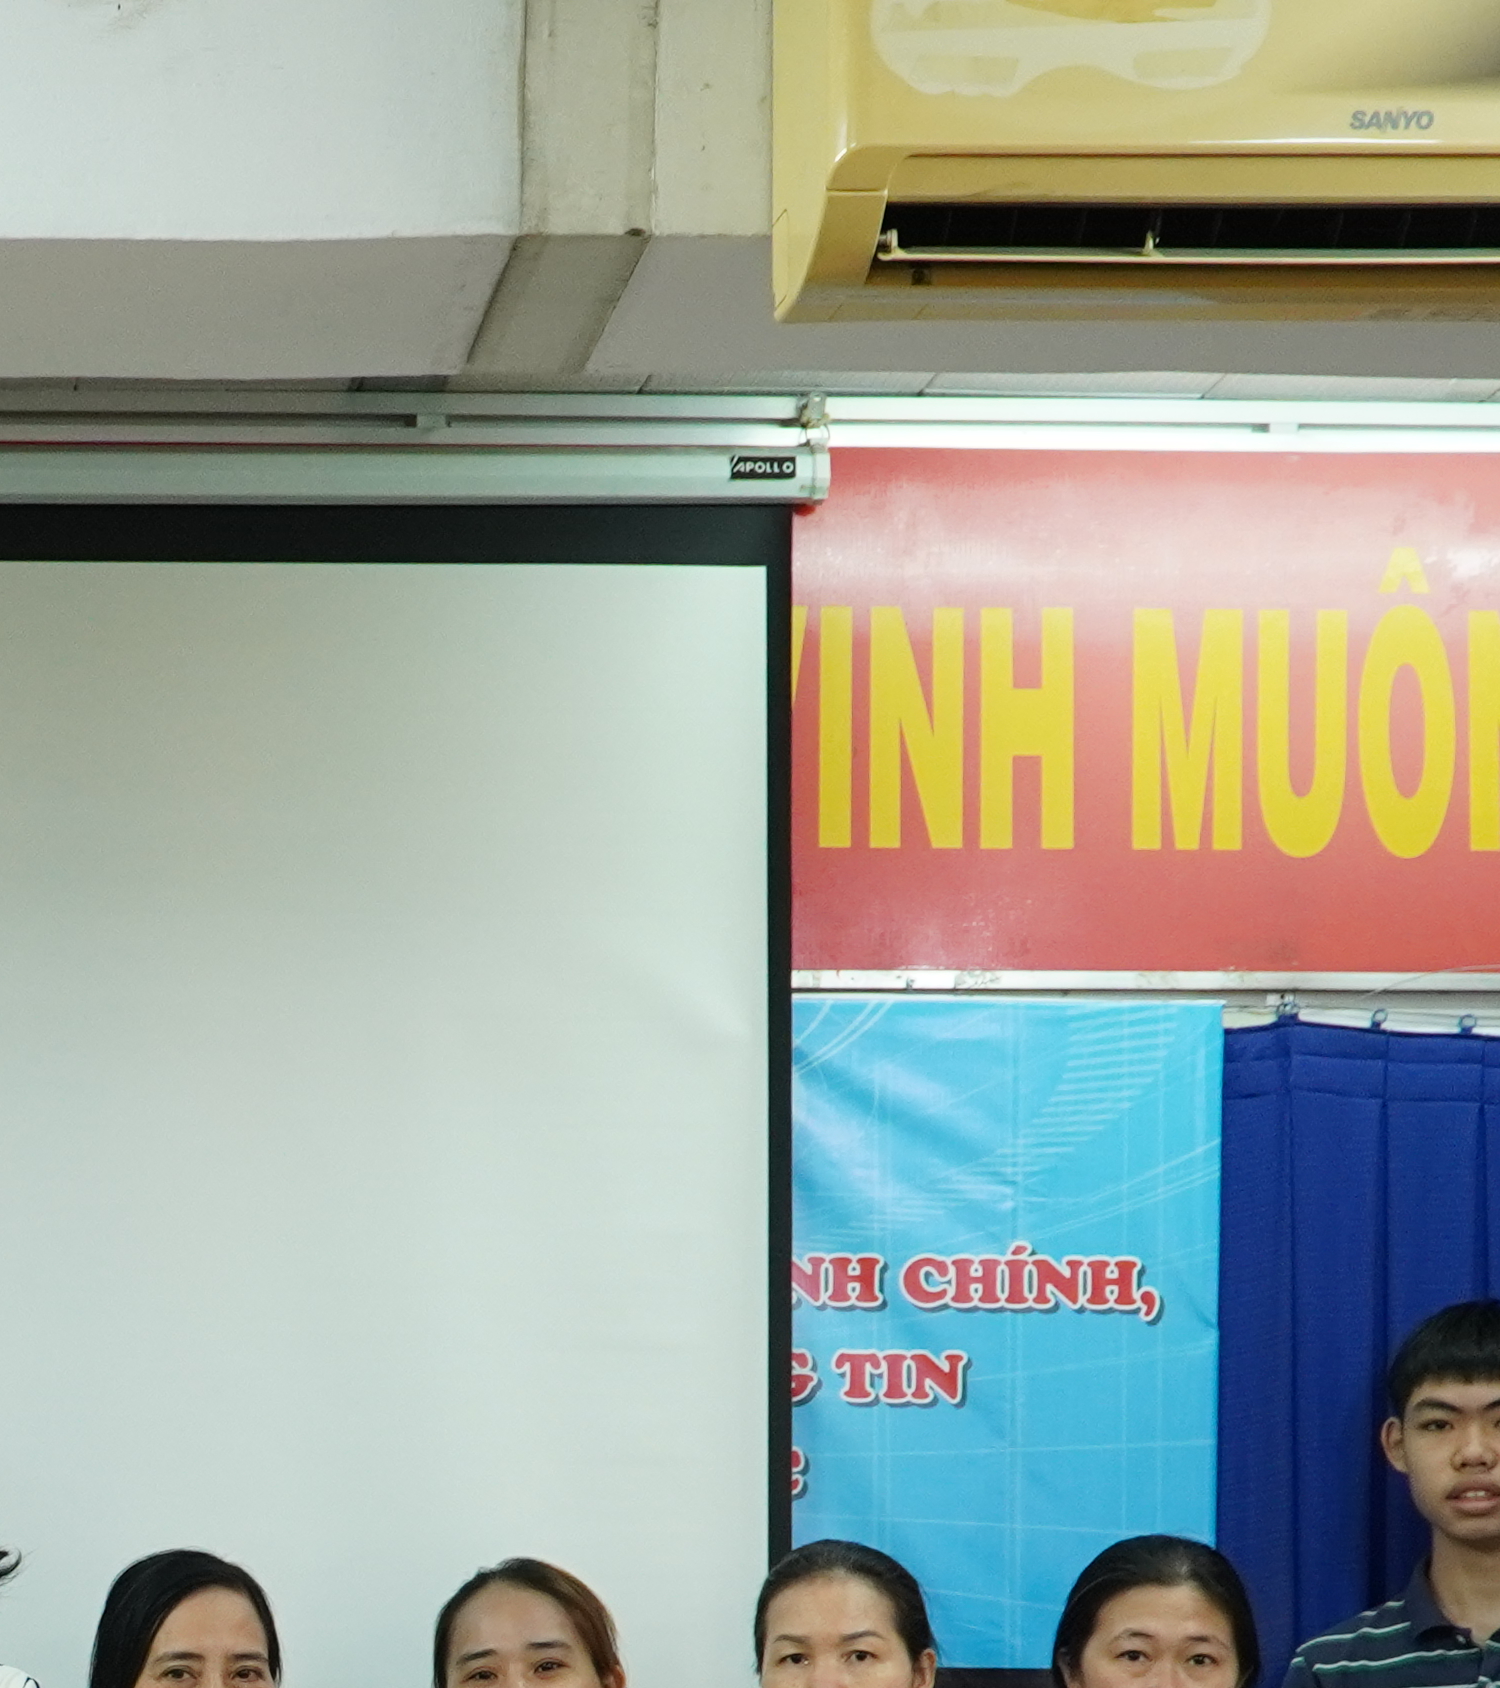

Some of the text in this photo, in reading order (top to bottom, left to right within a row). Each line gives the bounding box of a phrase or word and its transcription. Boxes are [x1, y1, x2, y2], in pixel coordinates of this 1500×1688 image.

[1349, 110, 1435, 131] SANYO
[733, 461, 795, 474] APOLLO
[791, 605, 1075, 850] INH
[902, 1243, 1158, 1320] CHÍNH,
[833, 1350, 966, 1402] TIN
